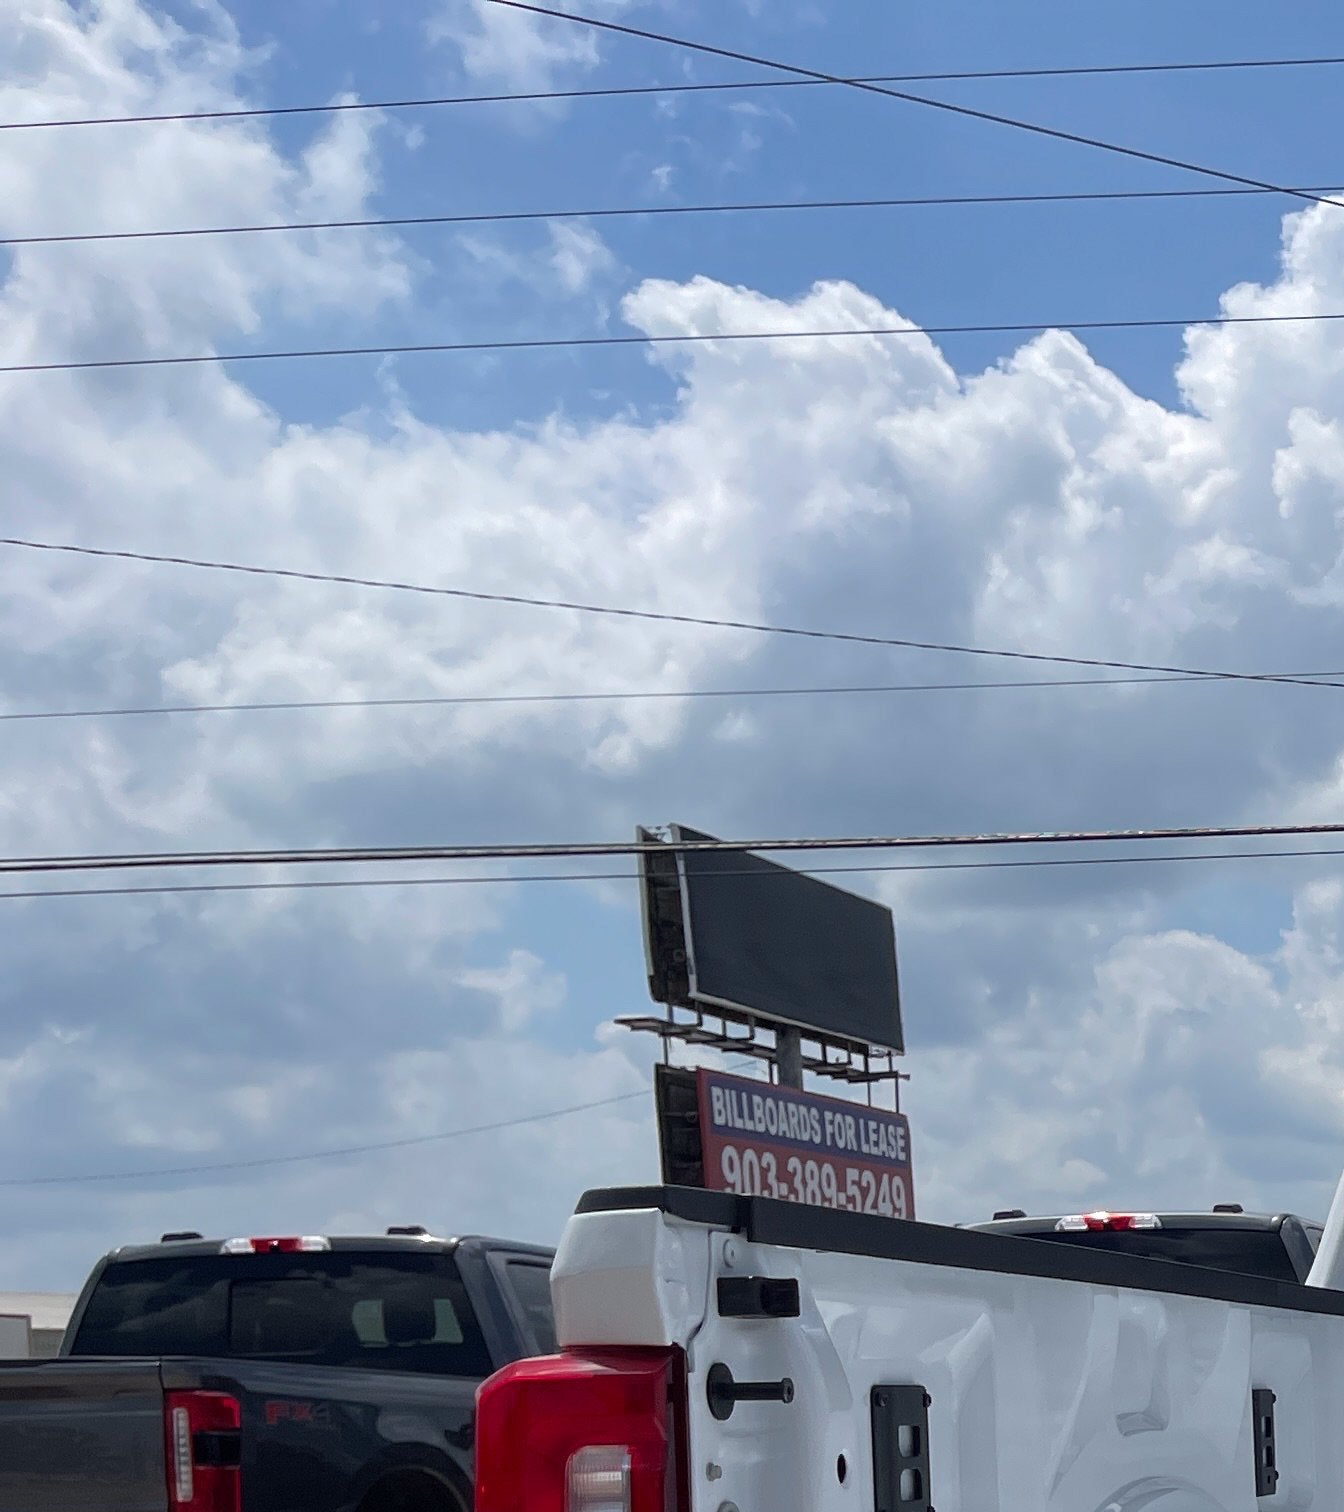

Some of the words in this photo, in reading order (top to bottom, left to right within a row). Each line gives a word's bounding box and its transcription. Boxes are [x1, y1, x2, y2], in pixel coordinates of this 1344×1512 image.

[710, 1086, 821, 1144] BILLBOARDS
[824, 1110, 858, 1151] FOR
[859, 1118, 906, 1161] LEASE
[721, 1145, 906, 1219] 903-389-5249
